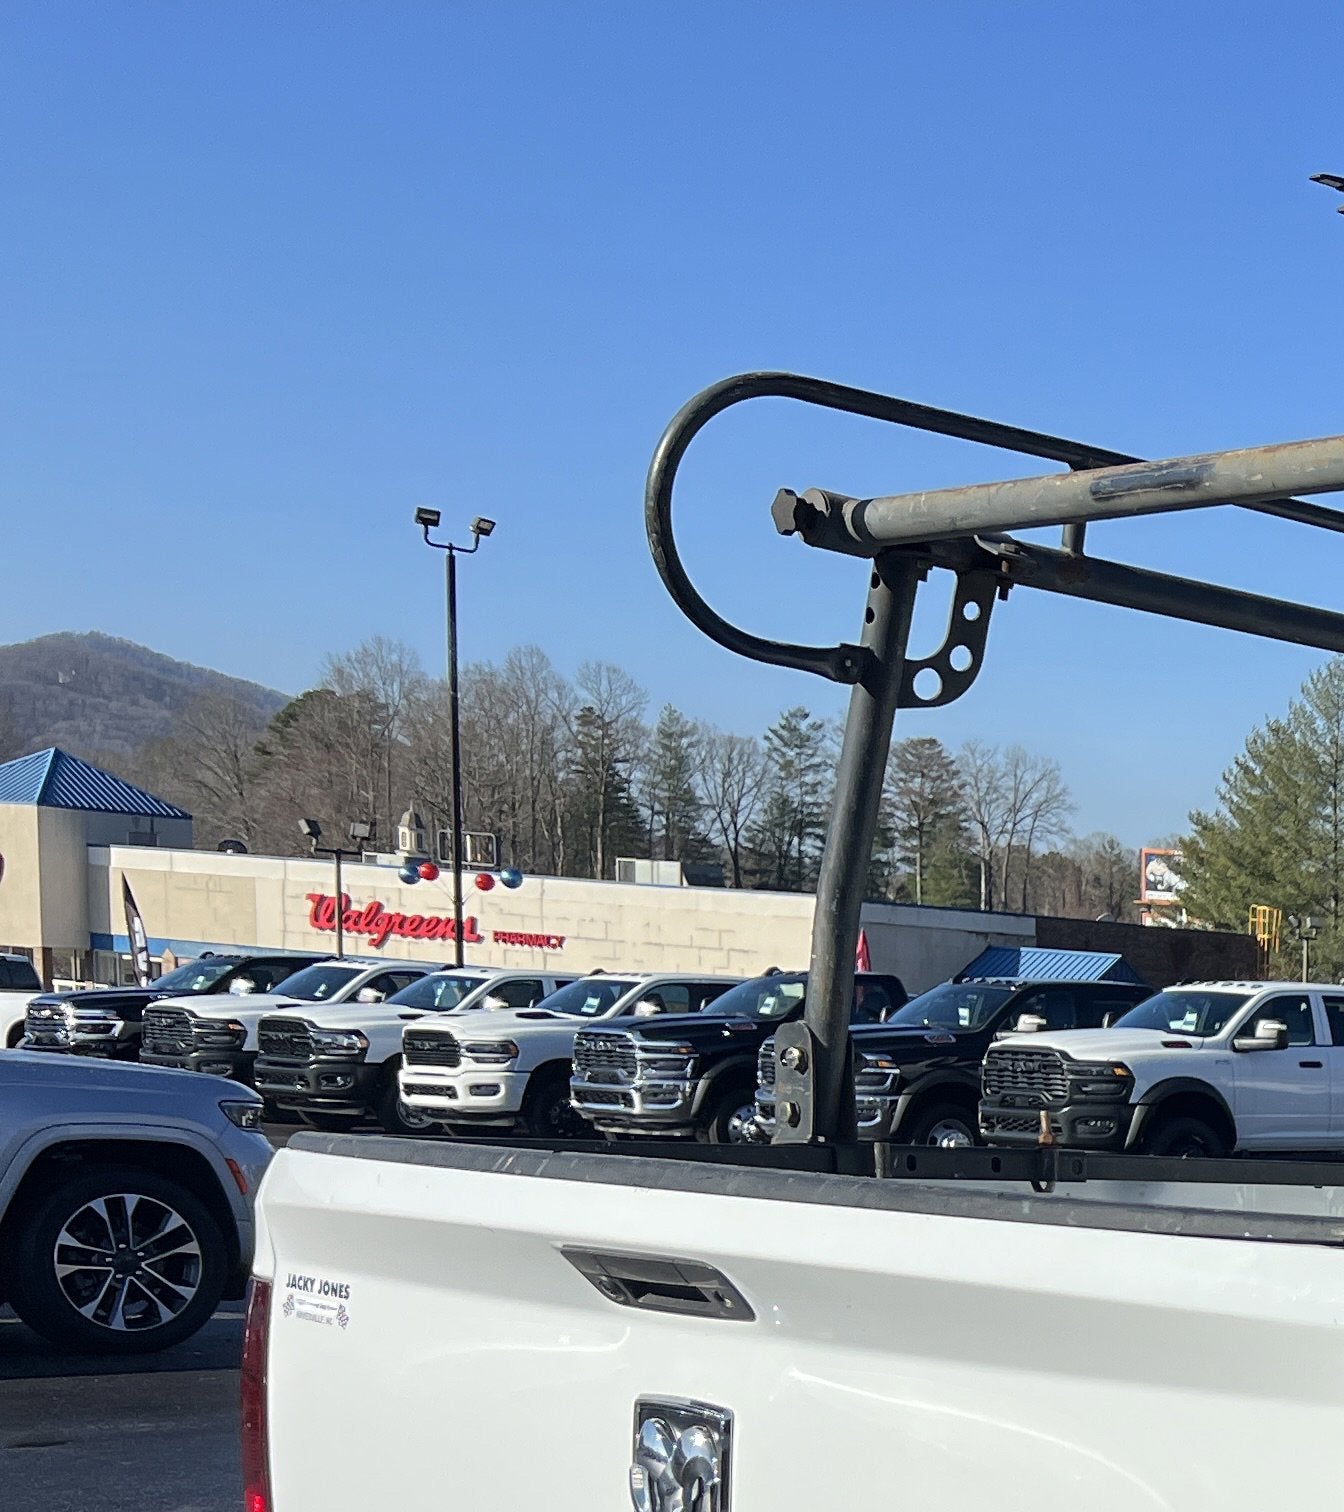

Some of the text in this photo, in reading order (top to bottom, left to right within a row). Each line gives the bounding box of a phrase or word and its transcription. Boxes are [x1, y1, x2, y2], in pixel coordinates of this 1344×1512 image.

[306, 893, 486, 949] Walgreens
[493, 930, 567, 949] PHARMACY
[286, 1273, 351, 1300] JACKY JONES
